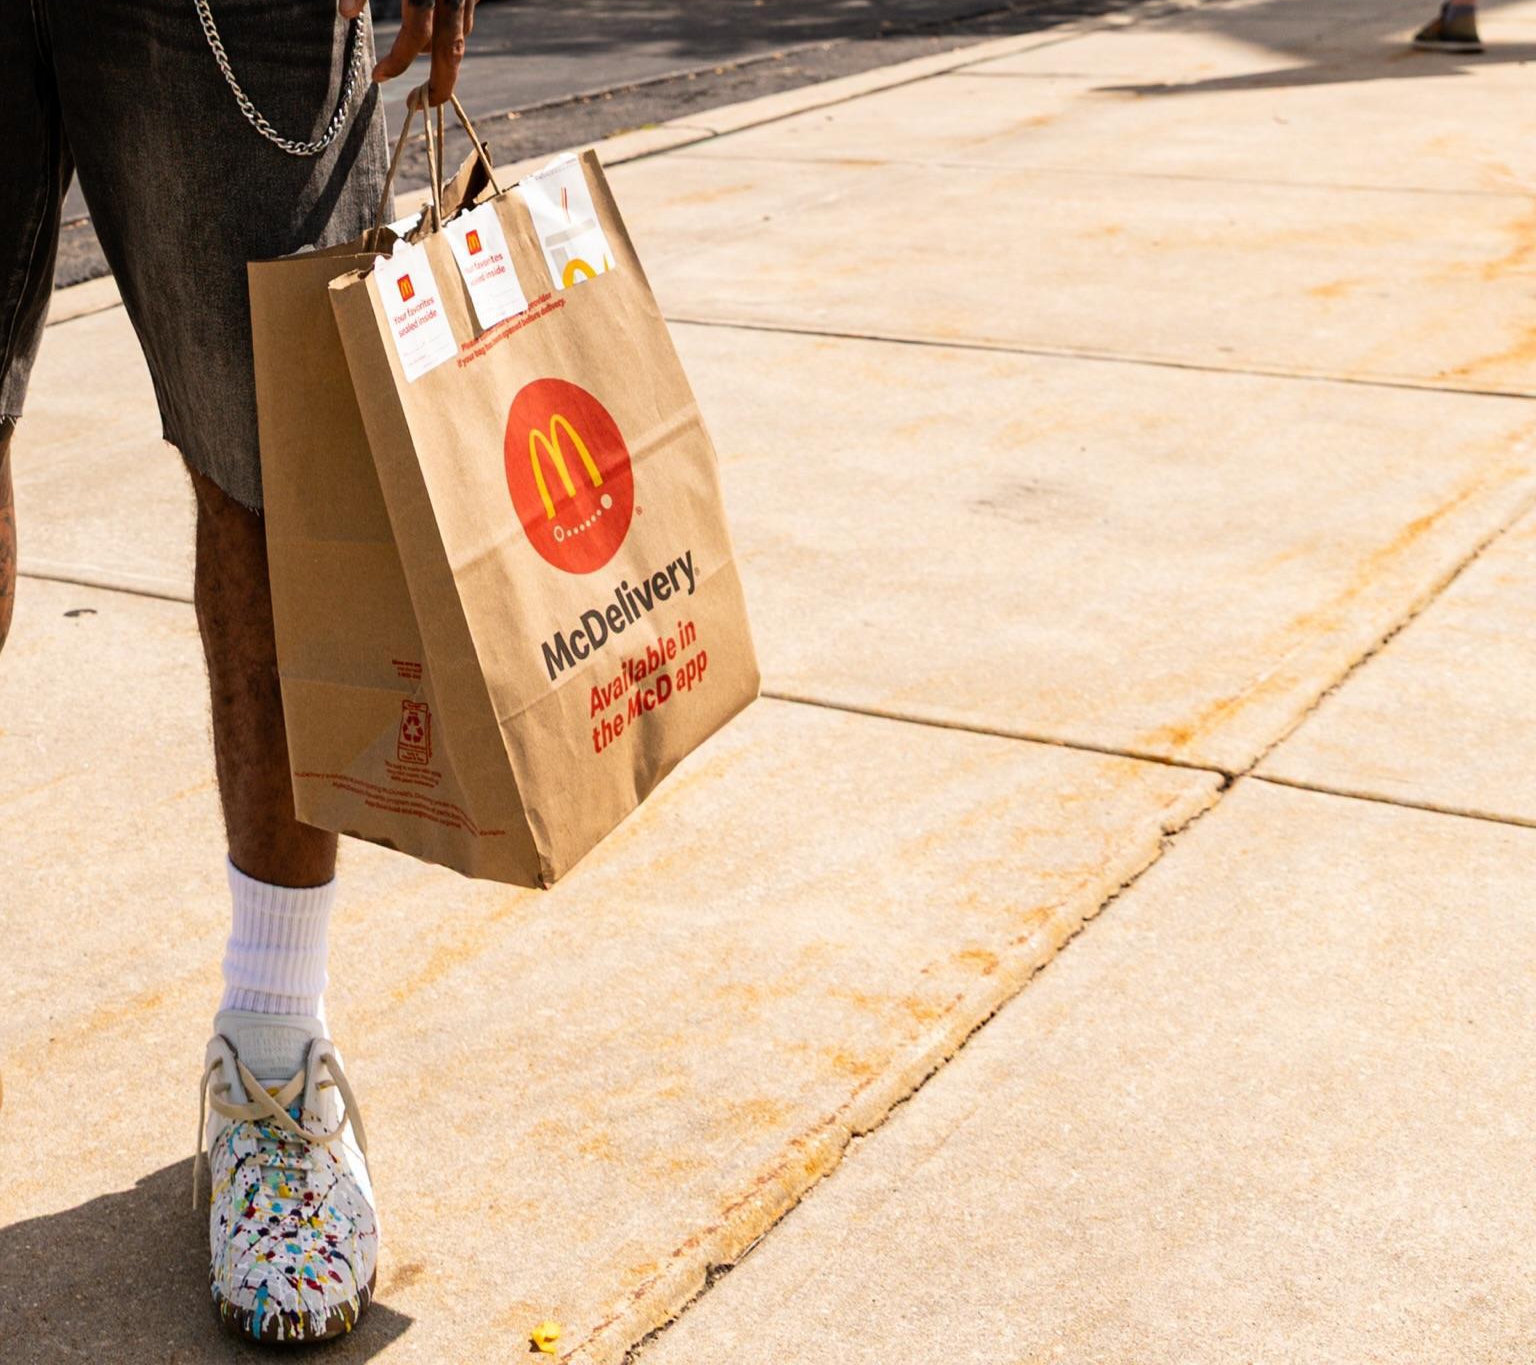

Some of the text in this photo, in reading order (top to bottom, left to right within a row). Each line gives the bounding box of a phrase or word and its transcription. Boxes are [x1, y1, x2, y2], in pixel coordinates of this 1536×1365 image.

[541, 549, 696, 681] McDelivery
[590, 619, 697, 719] Available in
[592, 649, 708, 755] the McD app
